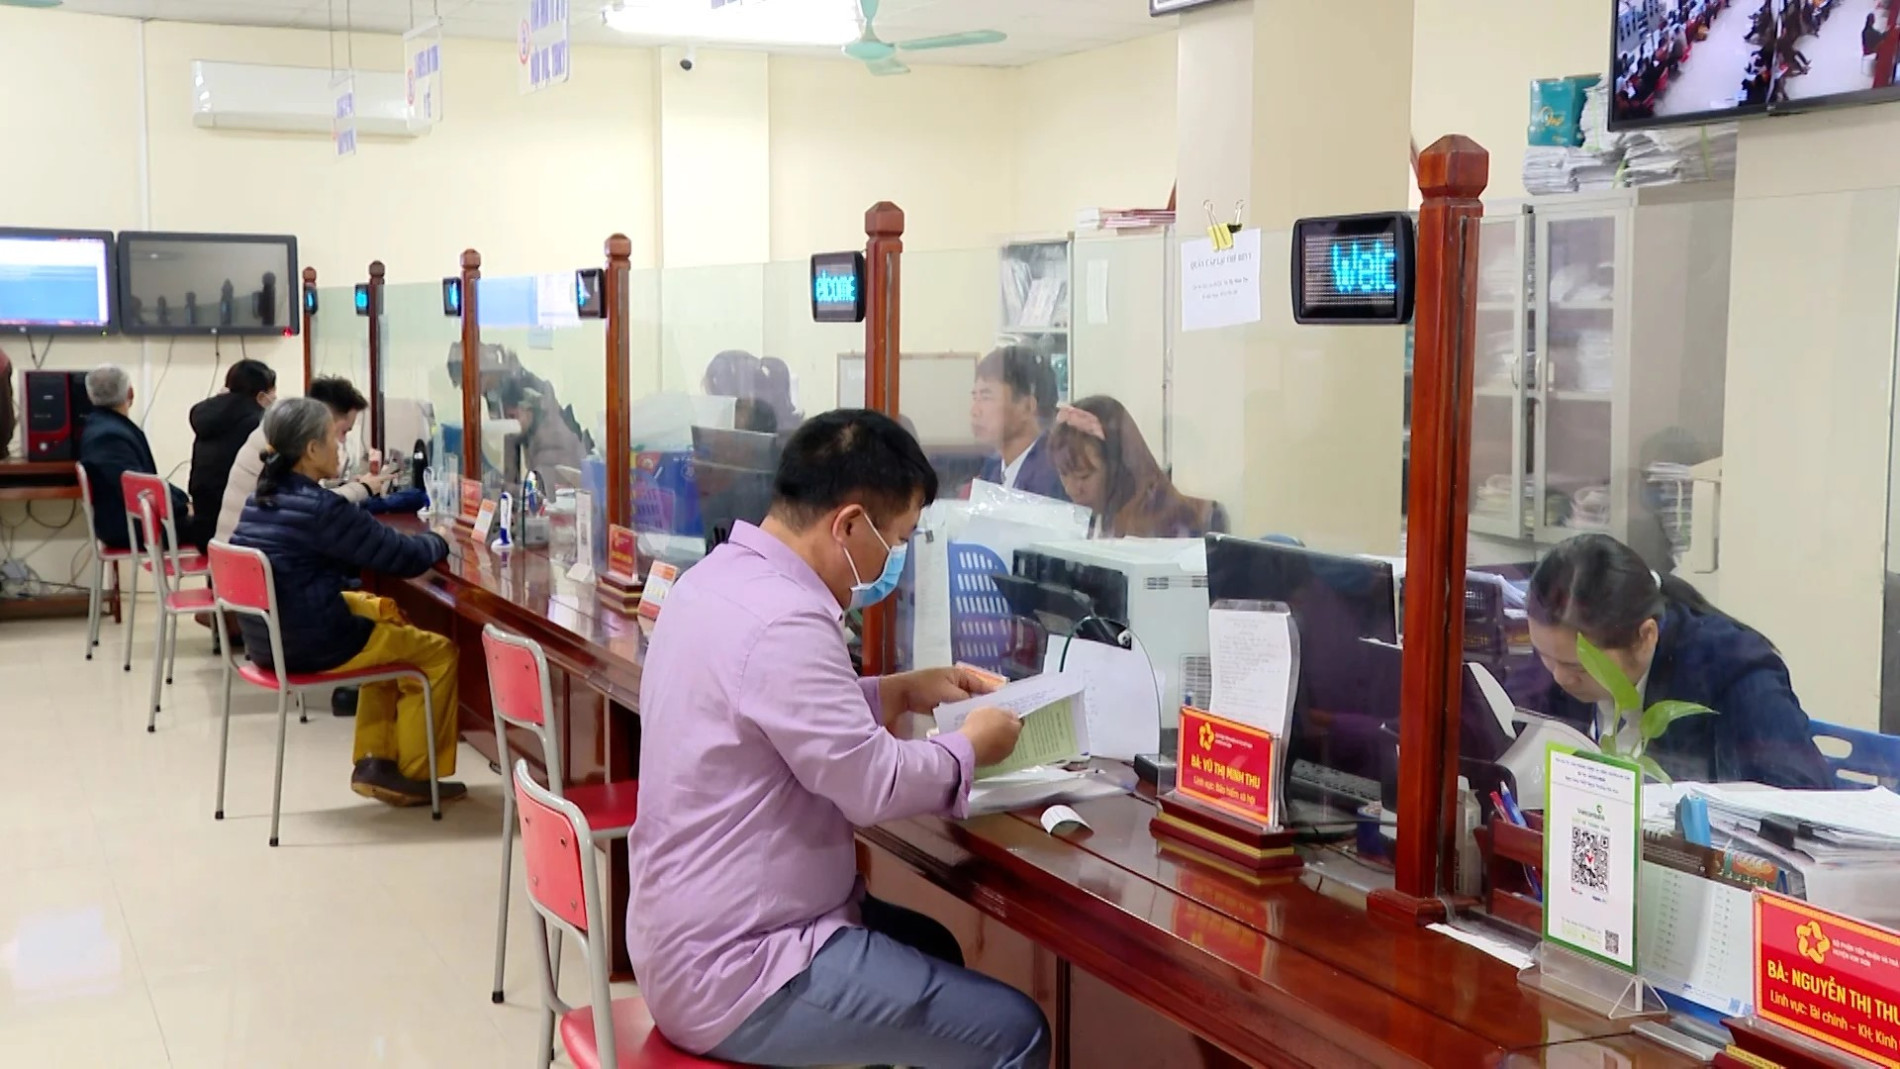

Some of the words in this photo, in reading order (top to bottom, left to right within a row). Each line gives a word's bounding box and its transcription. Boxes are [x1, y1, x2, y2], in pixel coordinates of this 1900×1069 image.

[1214, 762, 1225, 780] THỊ
[1226, 765, 1244, 783] MINH
[1768, 960, 1789, 983] BÀ:
[1792, 969, 1846, 1004] NGUYỄN
[1849, 989, 1871, 1019] THỊ
[1770, 989, 1789, 1009] Lĩnh
[1790, 998, 1808, 1016] vực:
[1822, 1010, 1848, 1031] chính
[1875, 1029, 1898, 1051] Kinh
